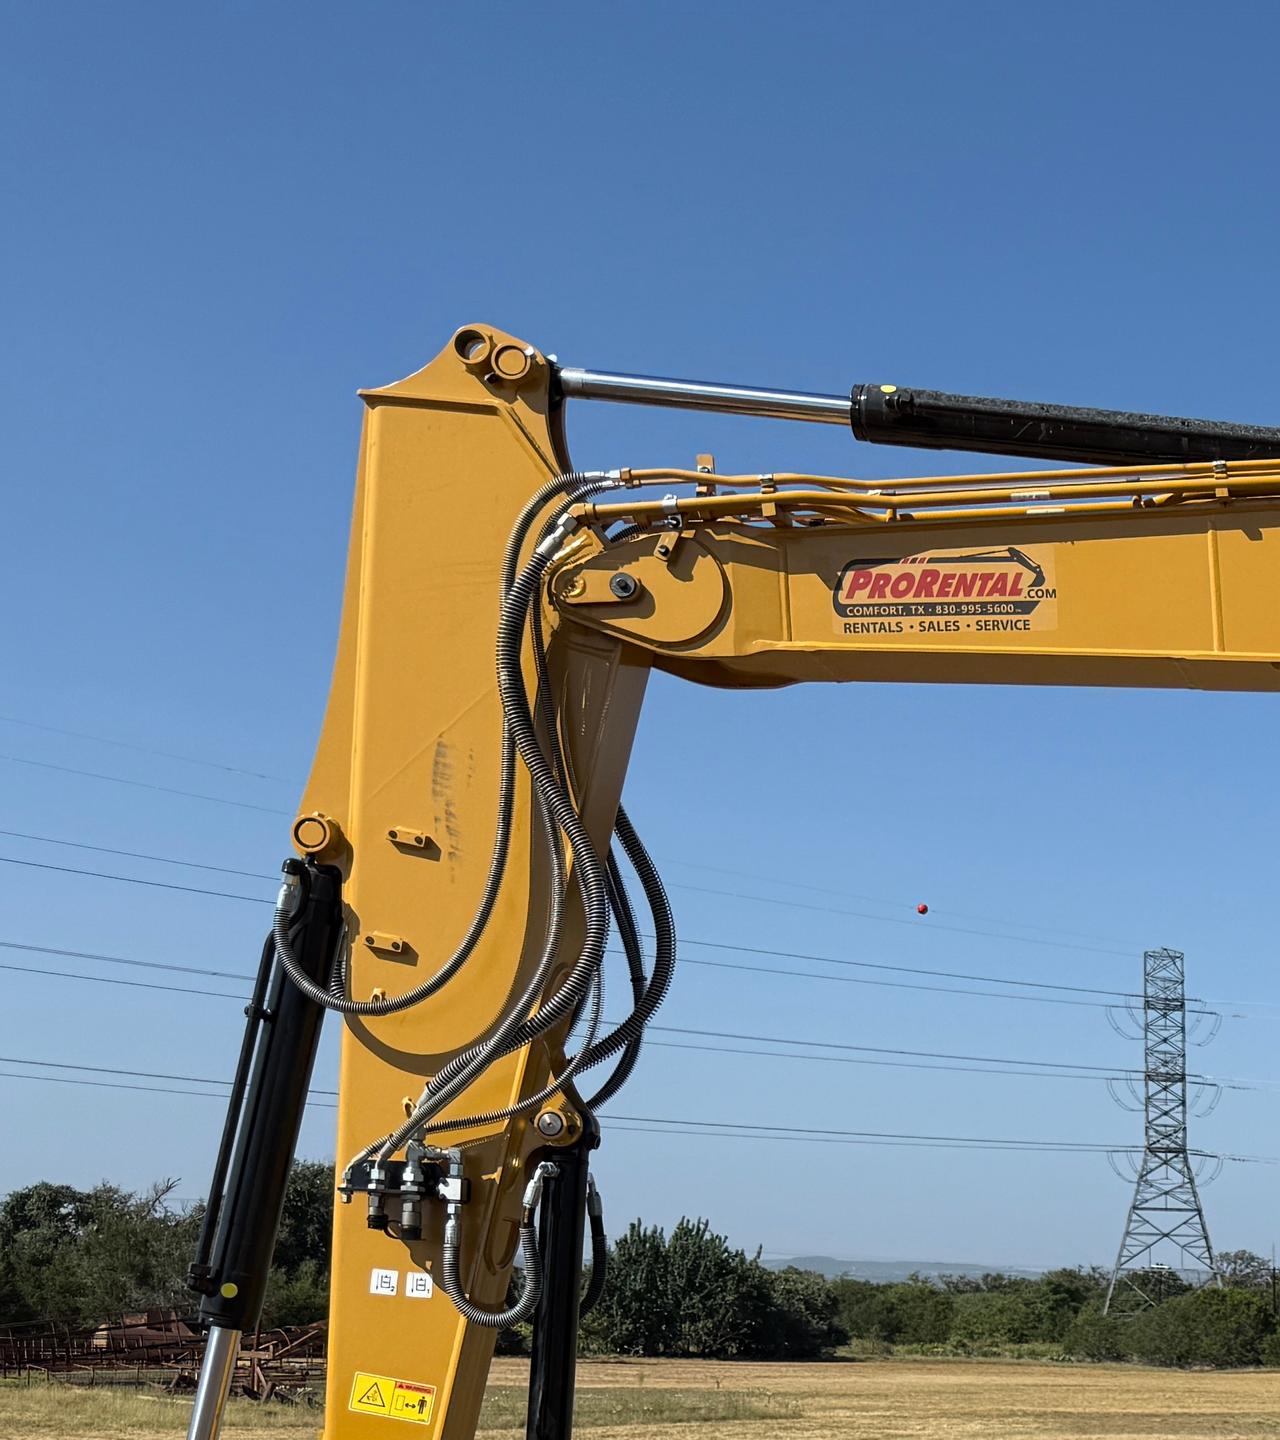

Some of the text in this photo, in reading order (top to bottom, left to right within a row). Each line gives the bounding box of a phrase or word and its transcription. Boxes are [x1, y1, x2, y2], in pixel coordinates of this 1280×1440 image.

[846, 604, 1015, 616] COMFORT, TX 830-995-5600
[843, 619, 1031, 634] RENTALS SALES SERVICE
